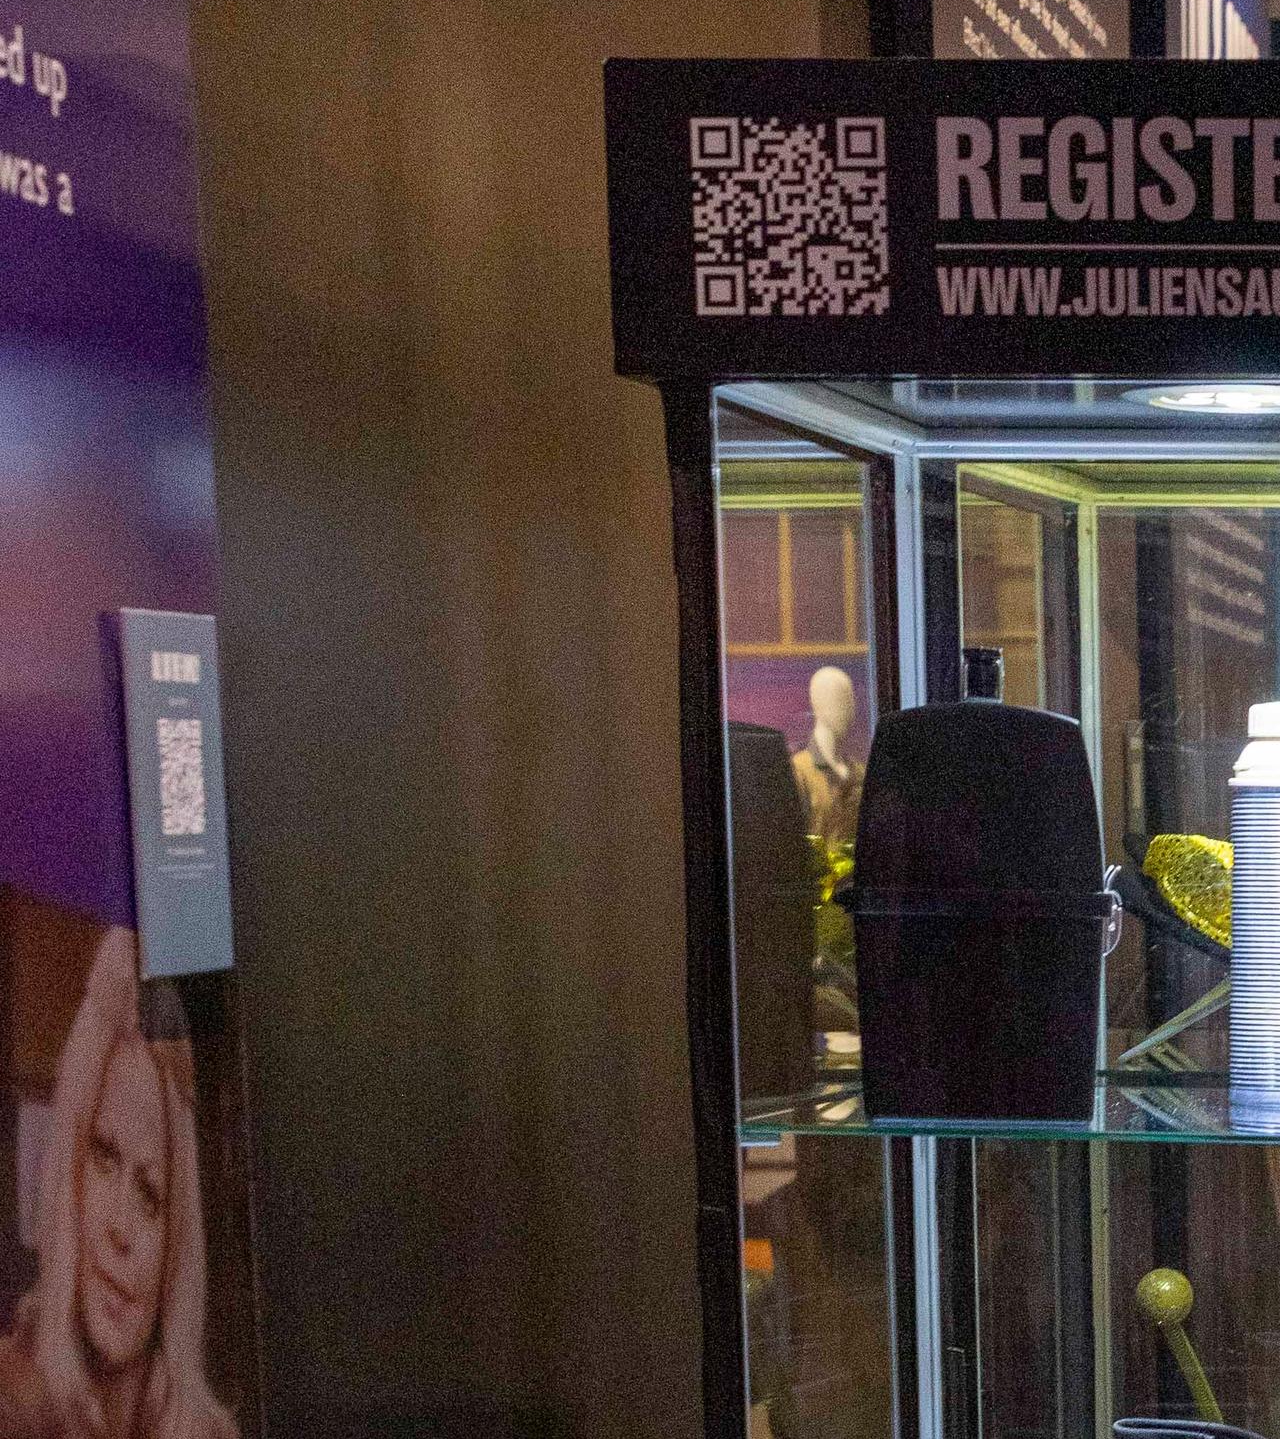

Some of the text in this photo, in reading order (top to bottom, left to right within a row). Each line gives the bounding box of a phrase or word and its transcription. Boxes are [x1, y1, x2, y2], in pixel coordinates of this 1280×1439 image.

[32, 51, 69, 119] up
[0, 149, 75, 217] was a
